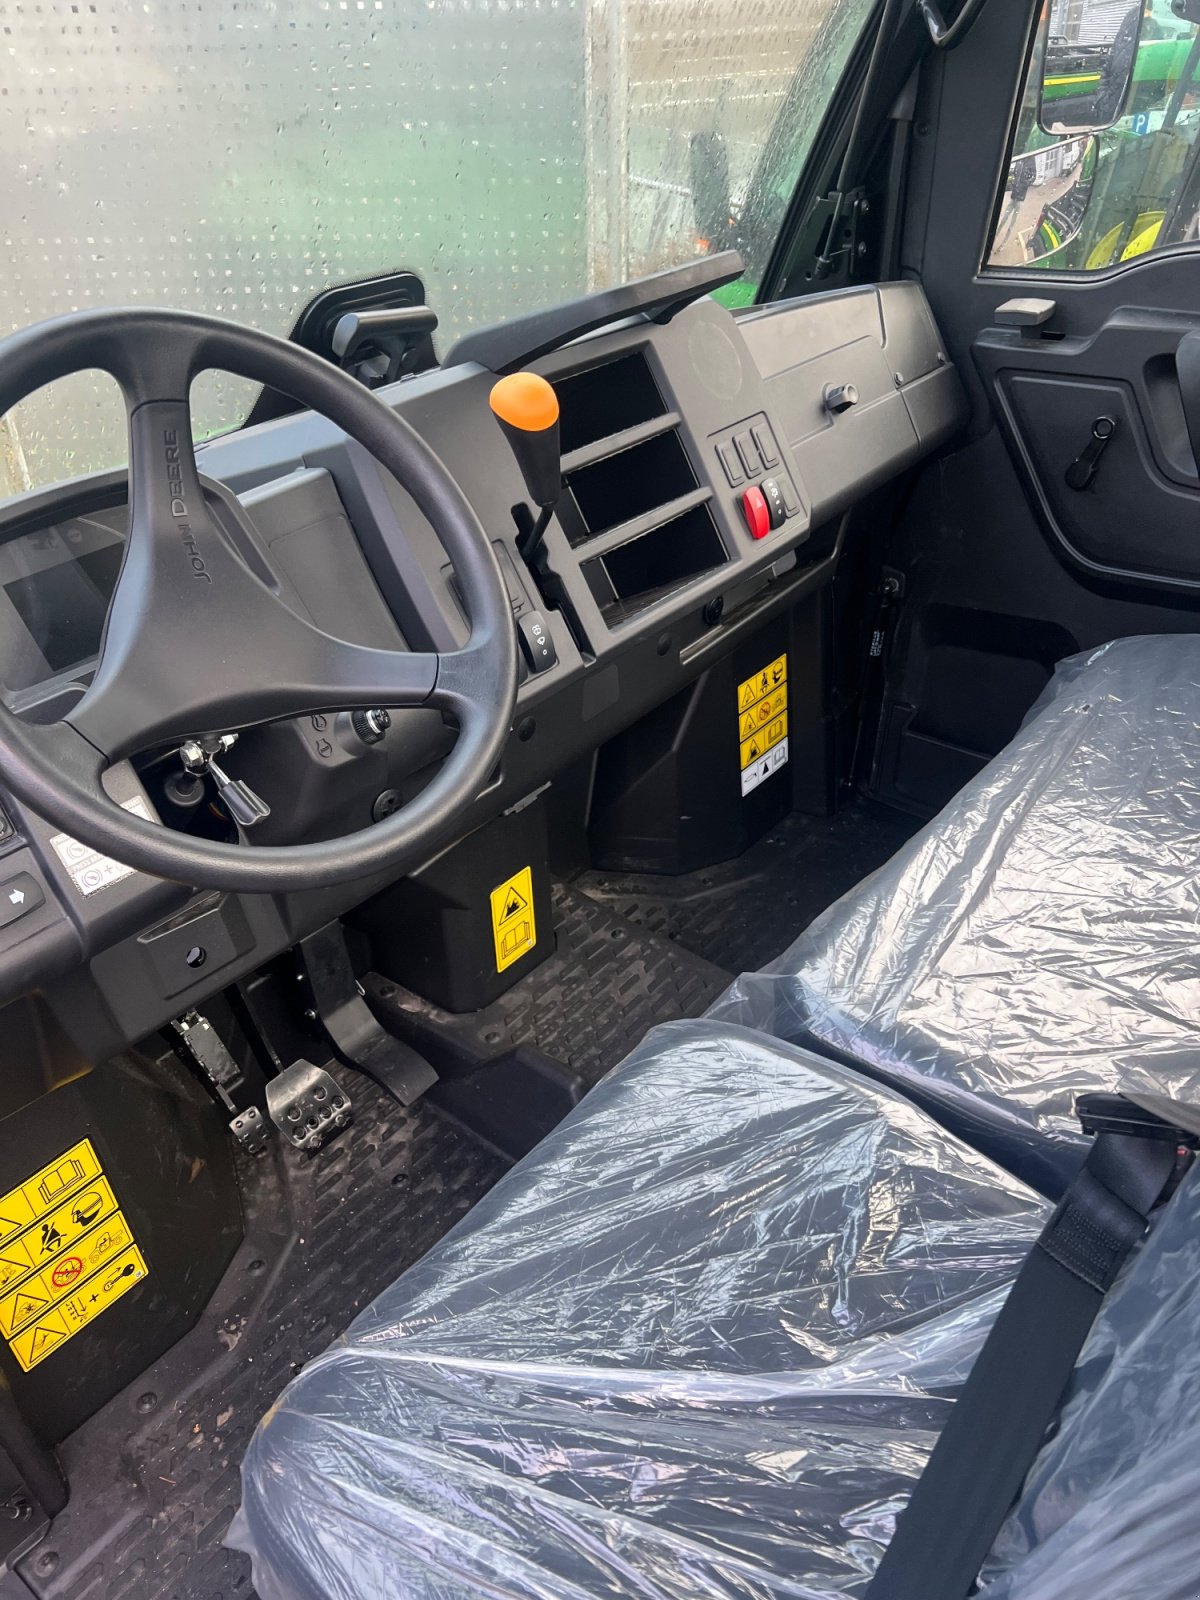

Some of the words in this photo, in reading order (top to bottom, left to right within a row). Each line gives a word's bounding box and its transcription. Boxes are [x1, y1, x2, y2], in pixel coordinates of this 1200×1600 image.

[1135, 114, 1146, 133] P
[164, 429, 188, 518] DEERE
[178, 523, 212, 584] JOHN
